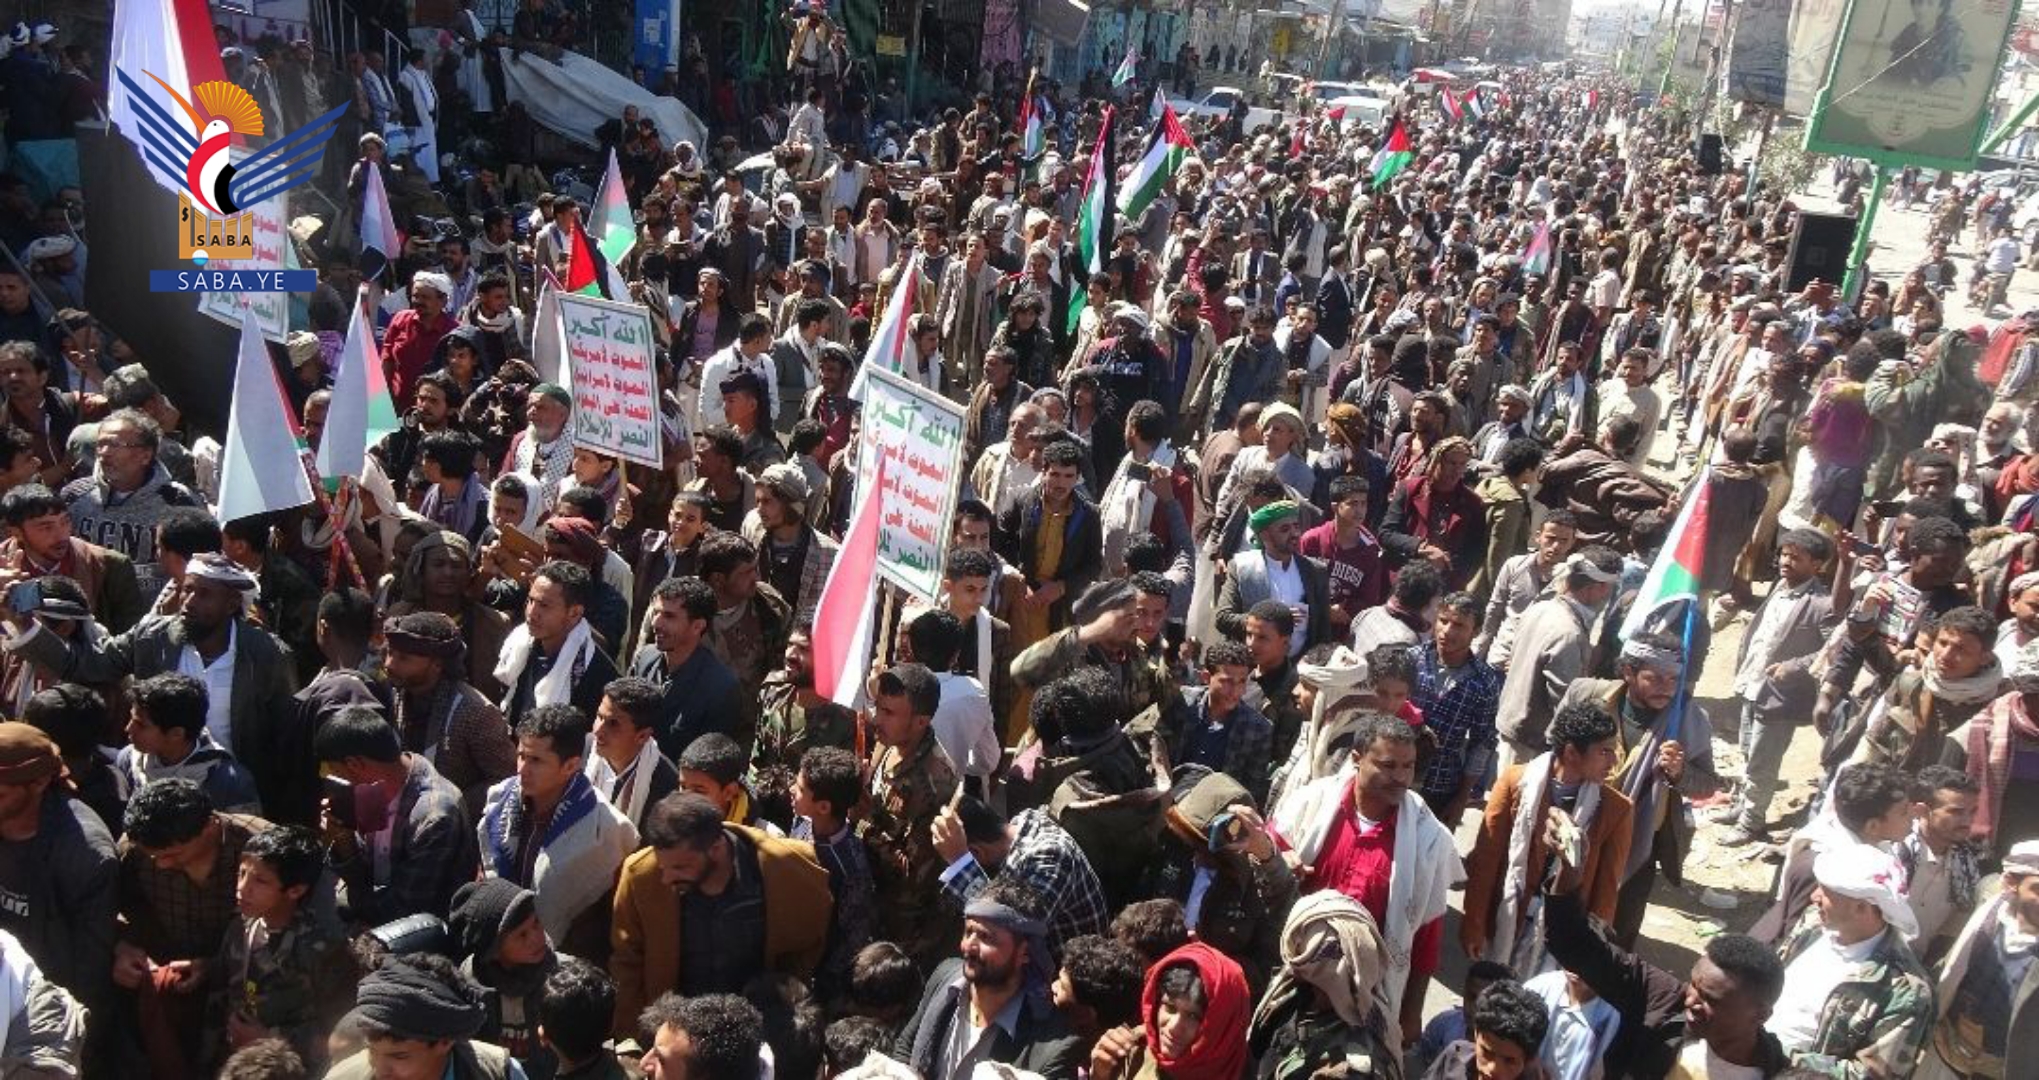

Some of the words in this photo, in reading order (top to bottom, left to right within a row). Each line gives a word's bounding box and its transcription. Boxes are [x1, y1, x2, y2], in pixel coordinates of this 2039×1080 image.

[568, 311, 611, 340] أكبر
[613, 318, 646, 345] الله
[611, 352, 648, 371] الموت
[613, 377, 651, 397] الموت
[869, 398, 922, 432] أكبر
[617, 424, 652, 448] النصر
[919, 412, 957, 449] الله
[907, 453, 949, 483] الموت
[902, 484, 944, 515] الموت
[893, 545, 935, 572] النصر
